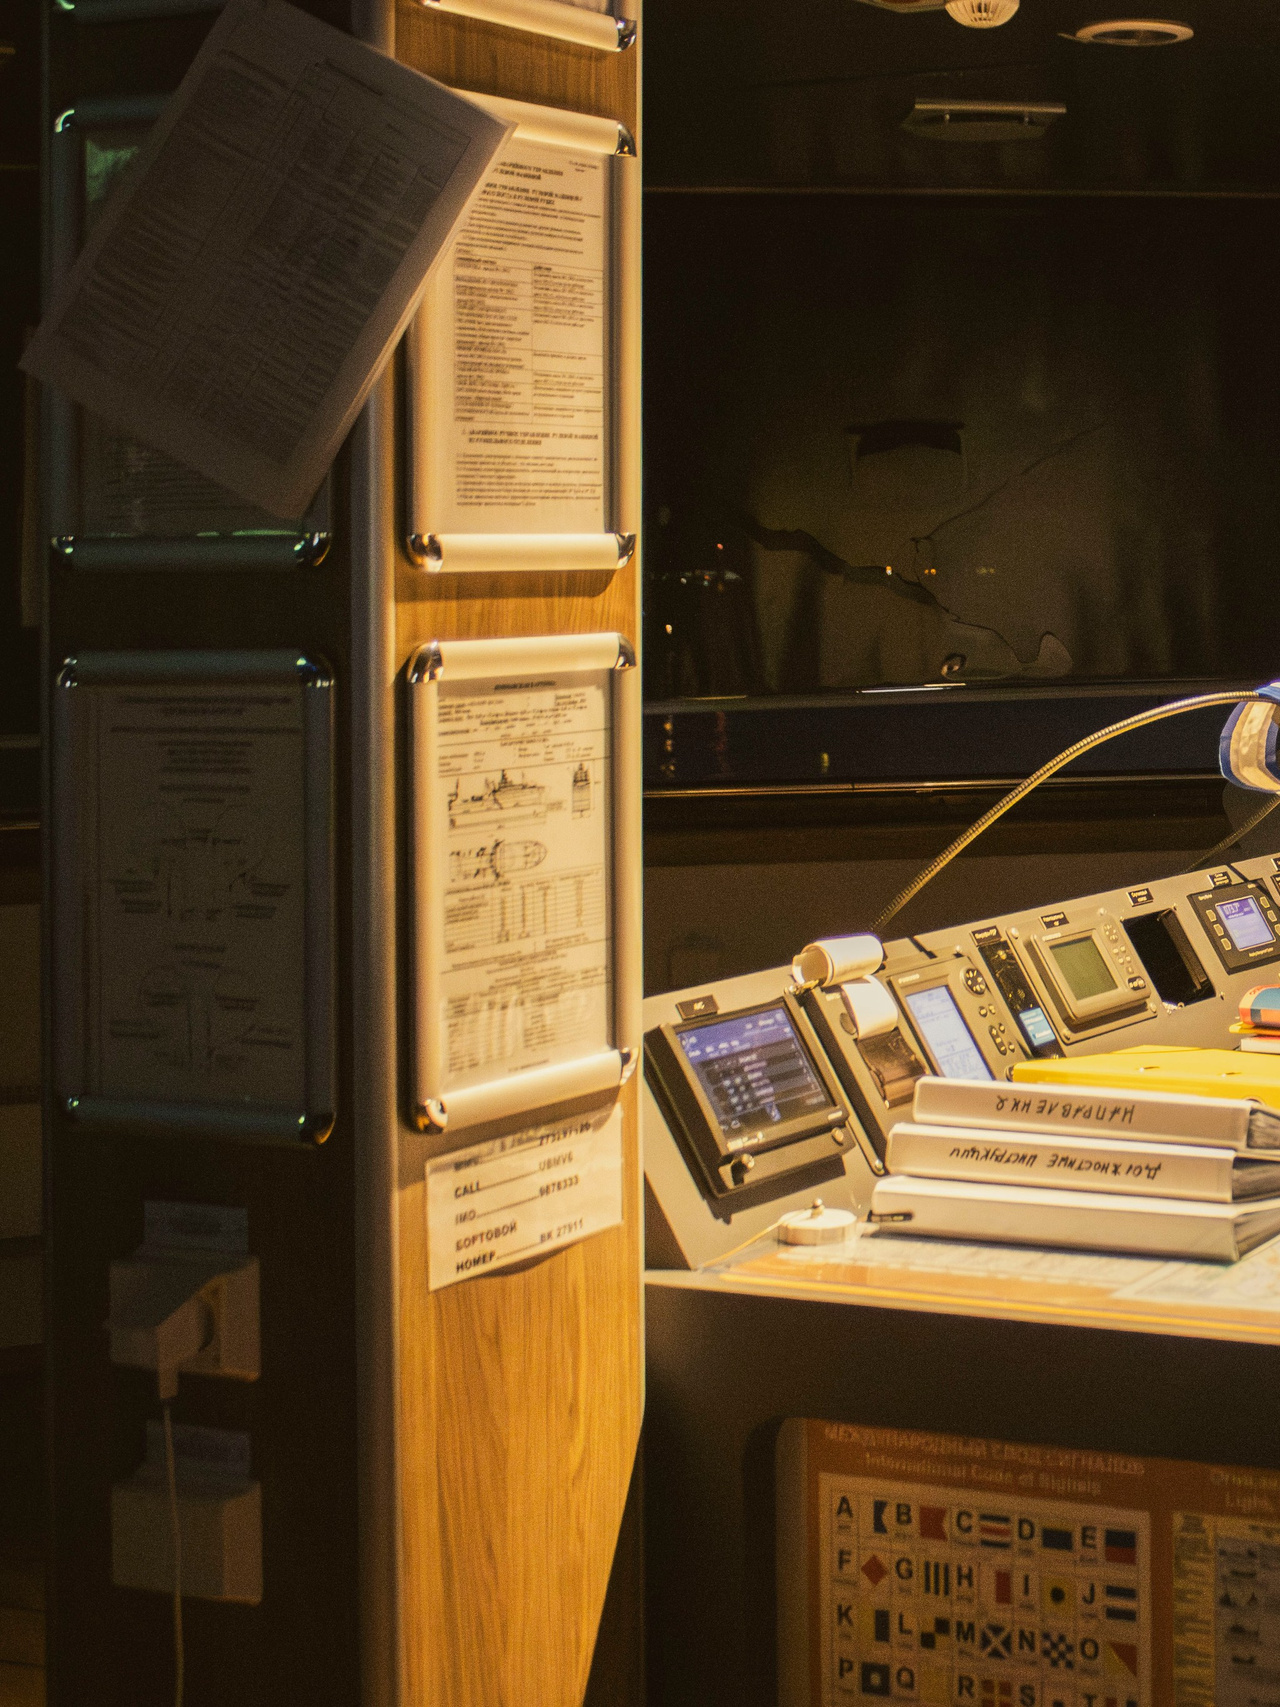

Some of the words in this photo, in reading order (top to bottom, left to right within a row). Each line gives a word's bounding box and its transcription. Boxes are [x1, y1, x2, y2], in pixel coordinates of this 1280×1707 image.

[454, 1180, 481, 1199] CALL
[455, 1208, 477, 1225] IMO
[455, 1218, 518, 1252] БОРТОВОЙ
[456, 1250, 496, 1274] НОМЕР
[836, 1495, 854, 1519] A
[896, 1503, 913, 1525] B
[956, 1511, 973, 1533] C
[1018, 1518, 1035, 1541] D
[1081, 1526, 1097, 1549] E
[838, 1550, 852, 1573] F
[895, 1558, 913, 1580] G
[956, 1564, 973, 1588] H
[1082, 1583, 1095, 1605] J
[837, 1605, 853, 1627] K
[899, 1612, 913, 1635] L
[956, 1620, 976, 1644] M
[1019, 1629, 1036, 1651] N
[1080, 1638, 1100, 1662] O
[839, 1657, 854, 1679] P
[896, 1667, 915, 1691] Q
[958, 1676, 975, 1698] R
[1019, 1685, 1036, 1707] S
